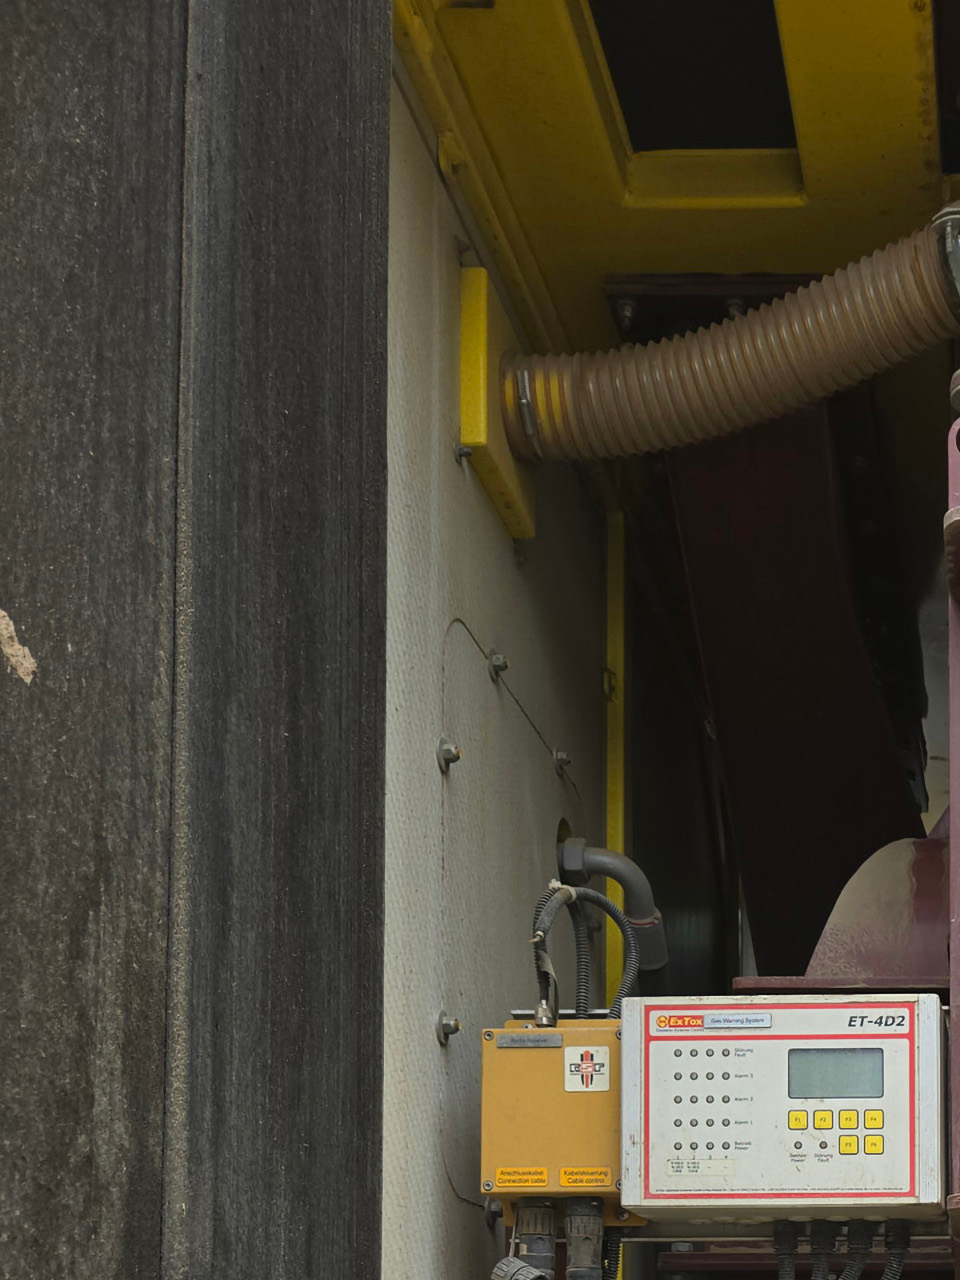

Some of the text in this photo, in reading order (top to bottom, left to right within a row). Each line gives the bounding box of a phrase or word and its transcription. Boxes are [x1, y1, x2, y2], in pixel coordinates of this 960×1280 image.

[669, 1017, 703, 1026] ExTox
[745, 1017, 765, 1025] System
[848, 1015, 906, 1027] ET-4D2
